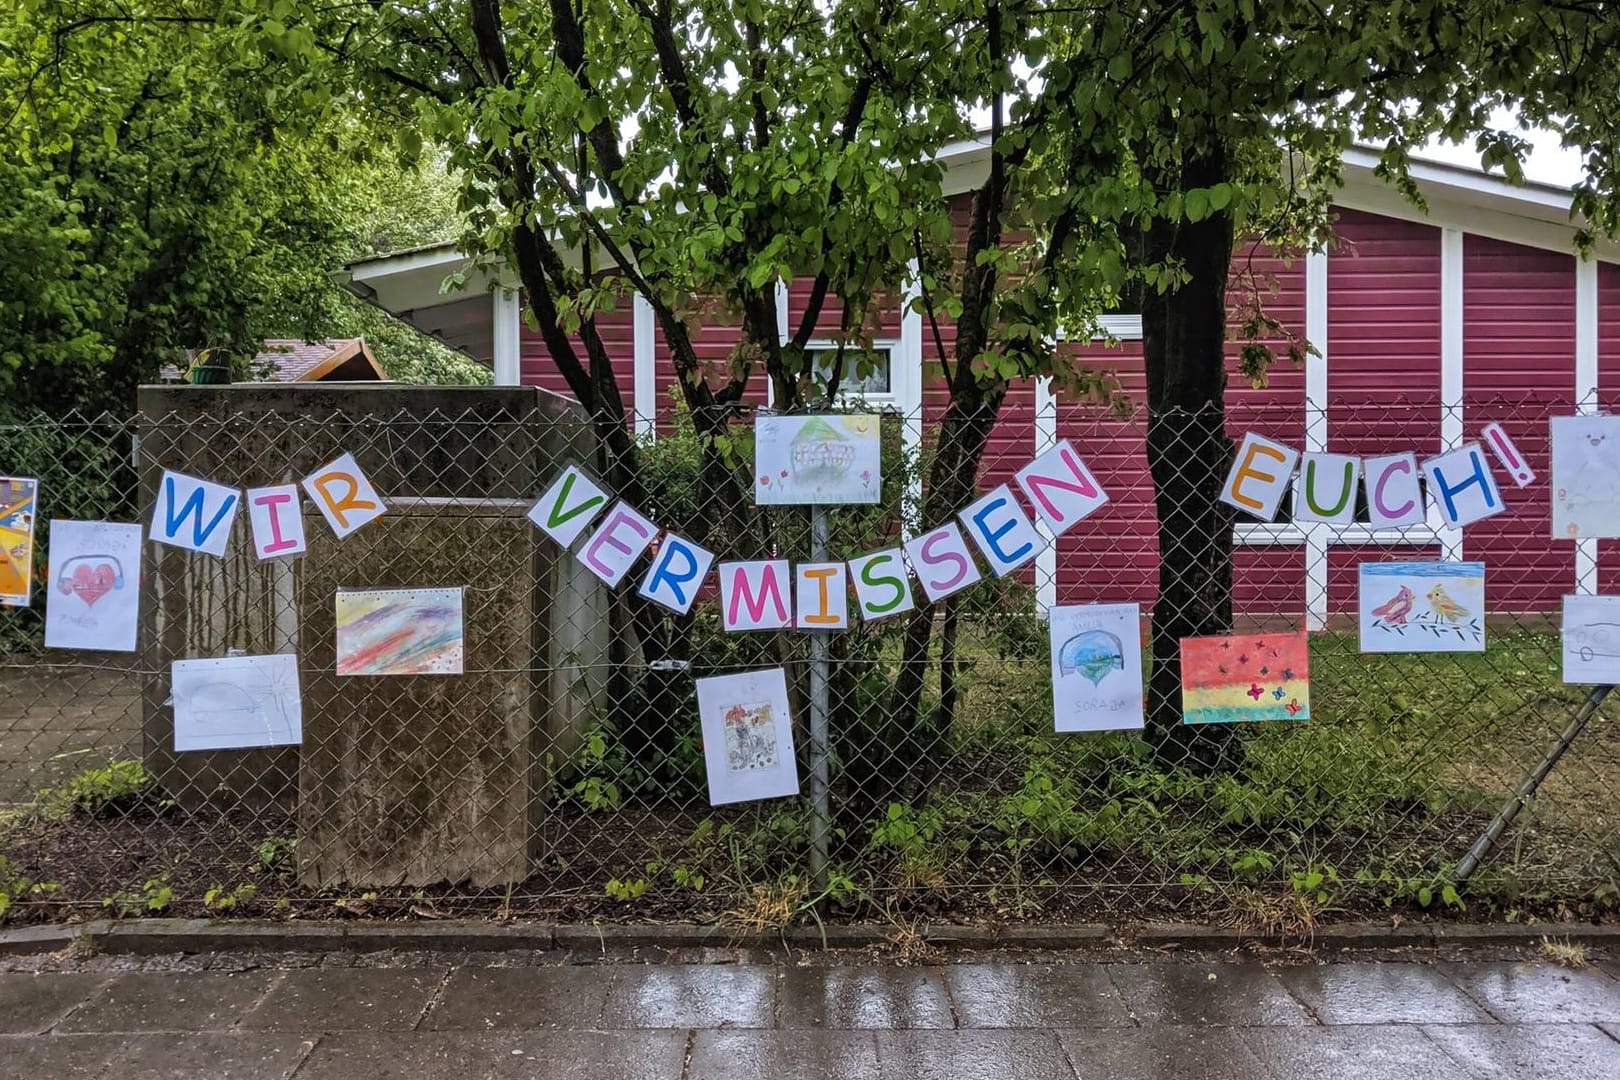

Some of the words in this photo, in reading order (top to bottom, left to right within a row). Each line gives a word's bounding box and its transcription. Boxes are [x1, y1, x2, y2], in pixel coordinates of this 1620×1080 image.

[165, 471, 377, 553] WIR
[547, 448, 1100, 625] VERMISSEN
[1230, 428, 1529, 522] EUCH!
